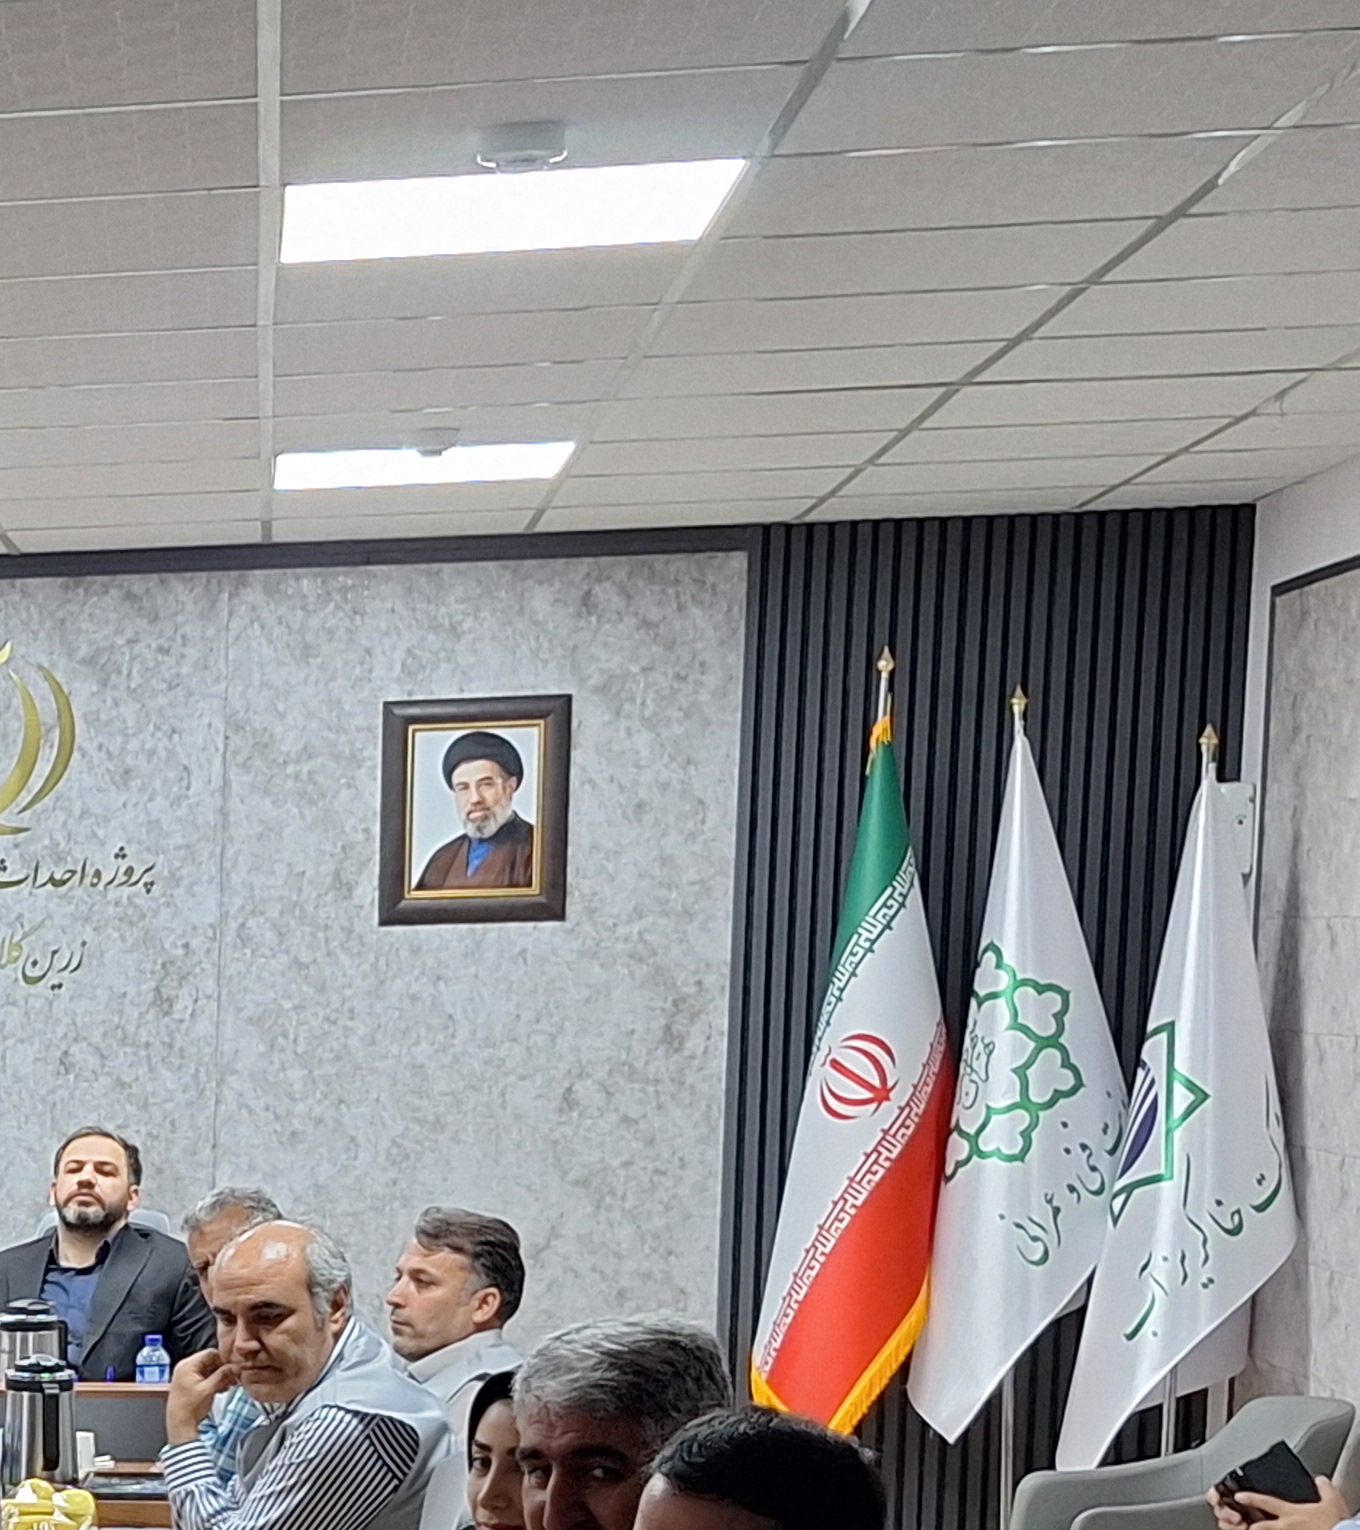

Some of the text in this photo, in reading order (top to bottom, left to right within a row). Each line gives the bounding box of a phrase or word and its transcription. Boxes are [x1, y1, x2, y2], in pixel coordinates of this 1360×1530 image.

[91, 847, 158, 894] پروژه
[22, 938, 87, 992] زرین
[1060, 1119, 1105, 1197] فنی
[997, 1191, 1062, 1267] عمرانی
